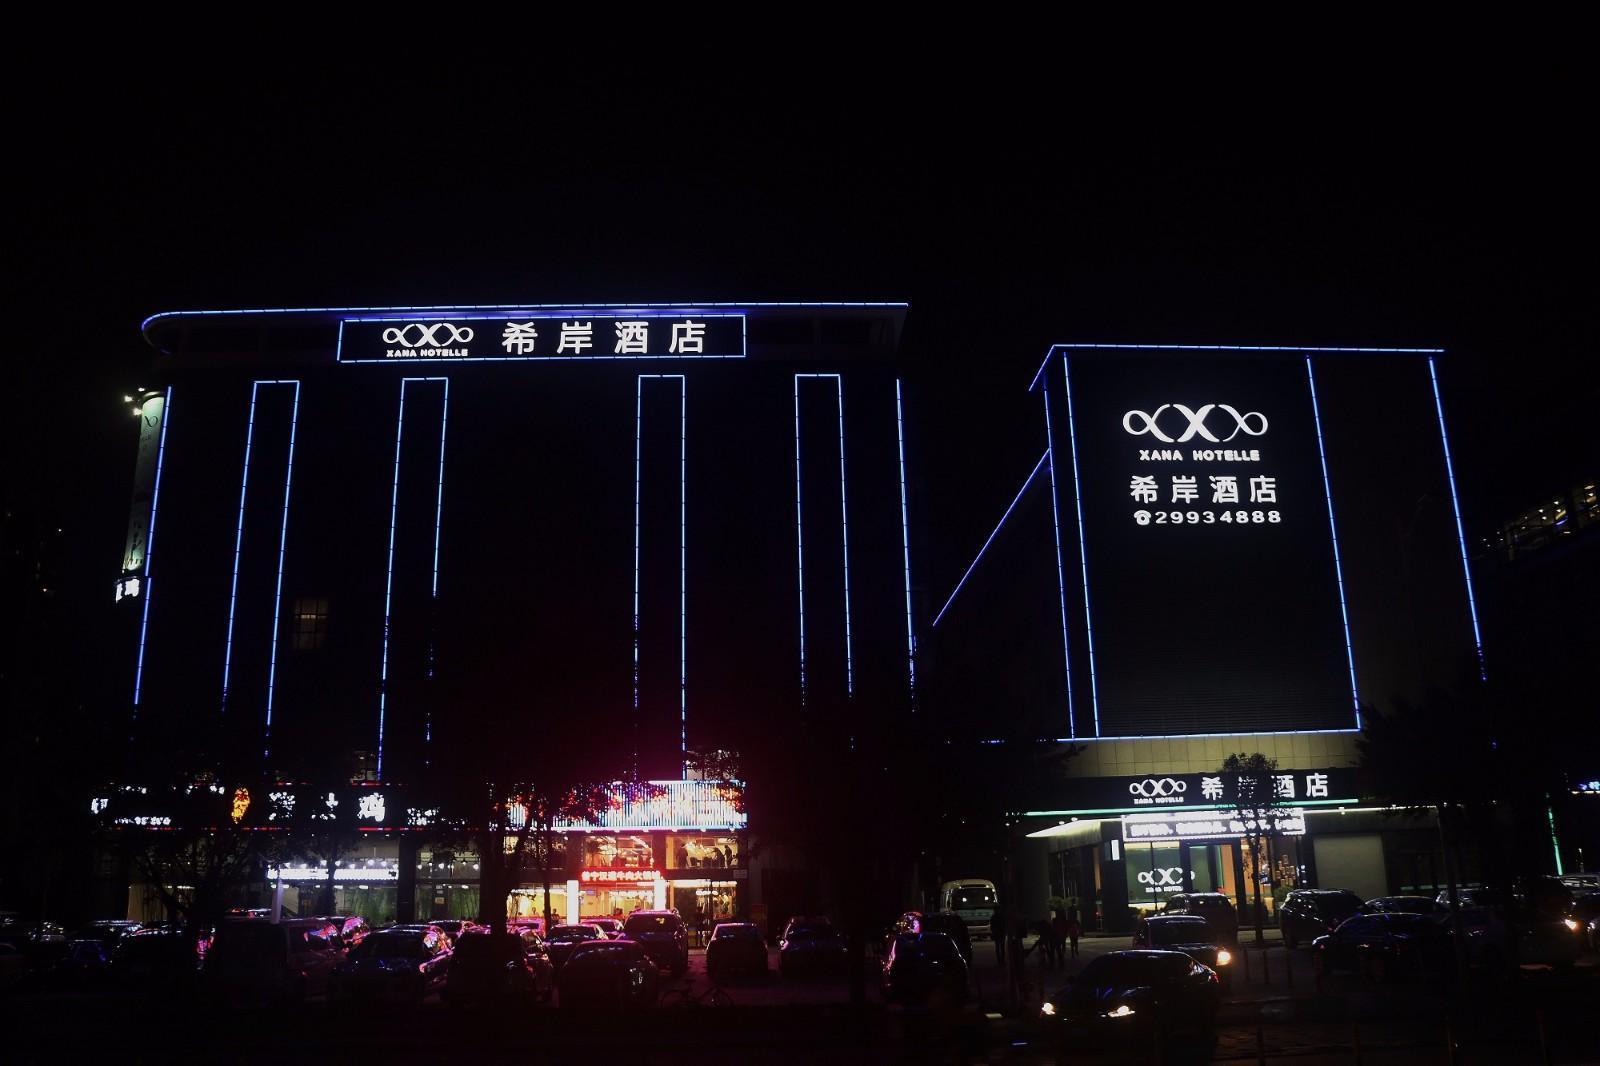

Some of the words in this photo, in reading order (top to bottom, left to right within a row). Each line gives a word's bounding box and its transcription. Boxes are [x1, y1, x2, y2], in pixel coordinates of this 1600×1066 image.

[501, 320, 706, 355] 希岸酒店
[386, 348, 418, 358] XANA
[420, 346, 469, 357] HOTELLE
[1139, 449, 1184, 462] XANA
[1192, 449, 1261, 462] HOTELLE
[1129, 474, 1277, 504] 希岸酒店
[1154, 510, 1282, 524] 29934888
[1201, 773, 1328, 800] 希酒店
